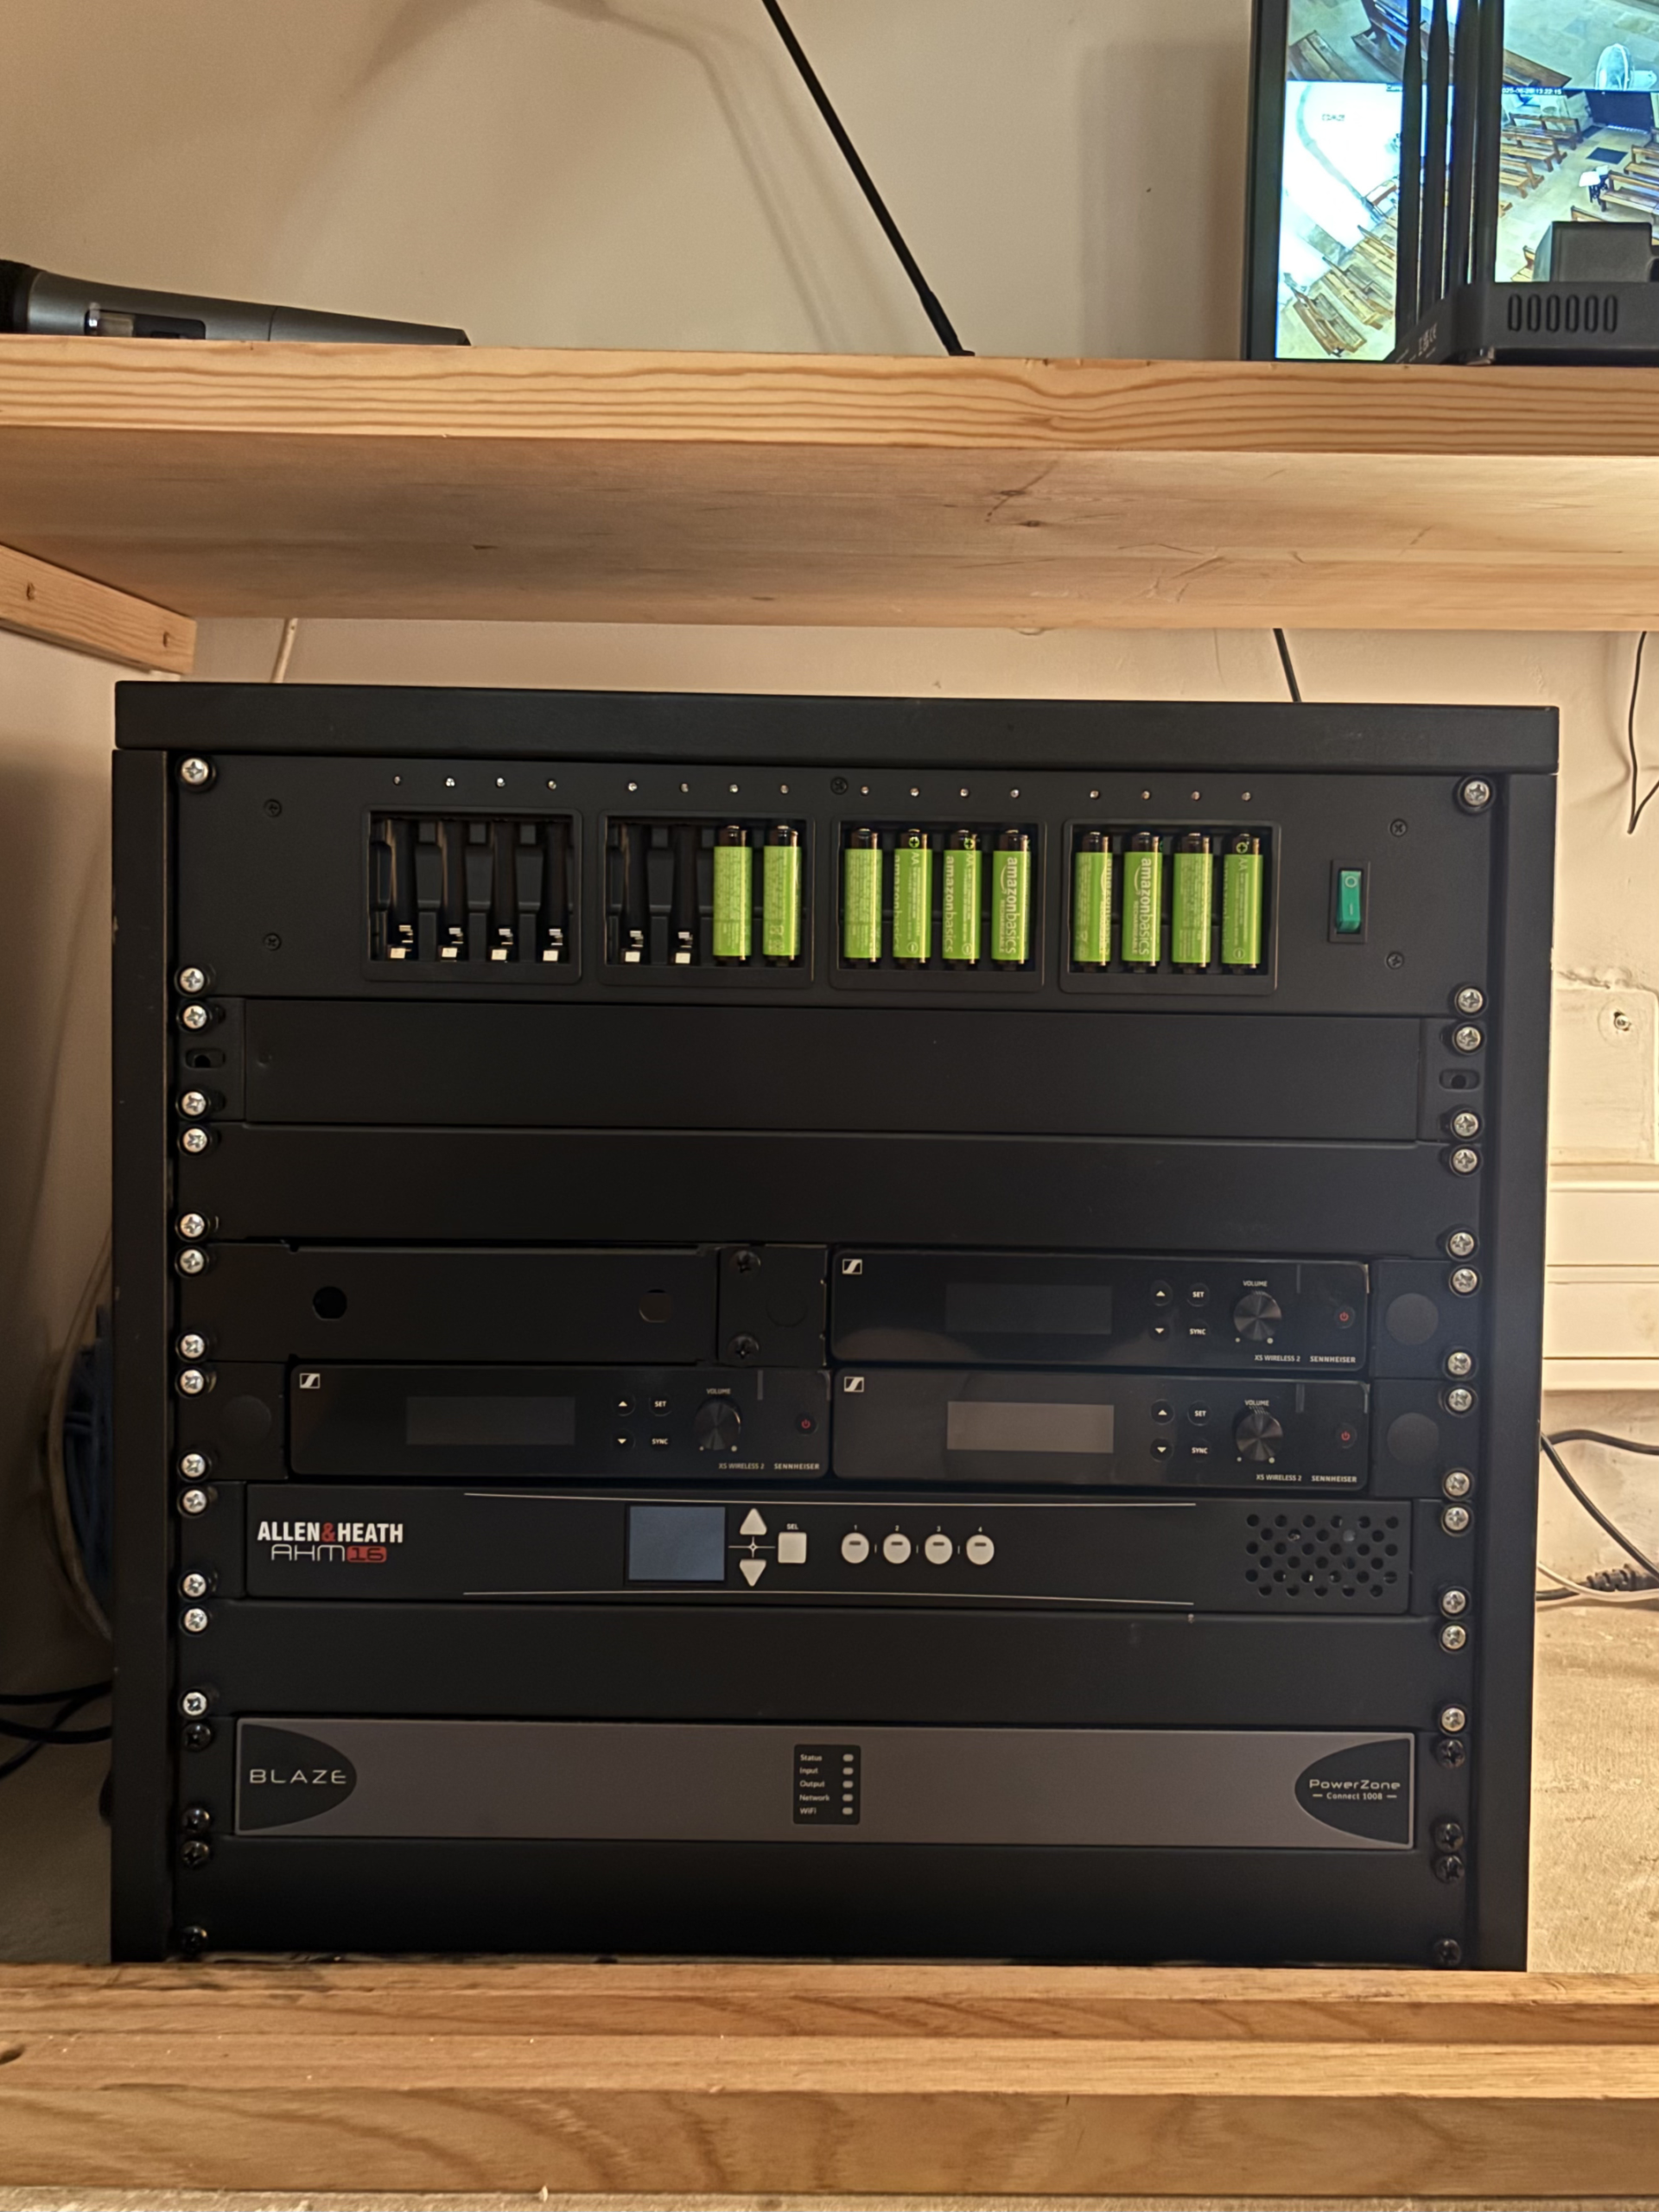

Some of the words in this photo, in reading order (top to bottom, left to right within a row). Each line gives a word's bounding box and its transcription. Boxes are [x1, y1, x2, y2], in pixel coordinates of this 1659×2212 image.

[911, 851, 920, 865] AA
[1238, 857, 1248, 872] AA
[944, 855, 957, 952] amazonbasics
[1006, 856, 1020, 954] amazonbasics
[1138, 857, 1153, 956] amazonbasics
[257, 1521, 404, 1543] ALLEN&HEATH
[250, 1769, 346, 1784] BLAZE
[1309, 1778, 1401, 1790] PowerZone
[799, 1780, 825, 1789] Output
[1363, 1792, 1382, 1801] 1008
